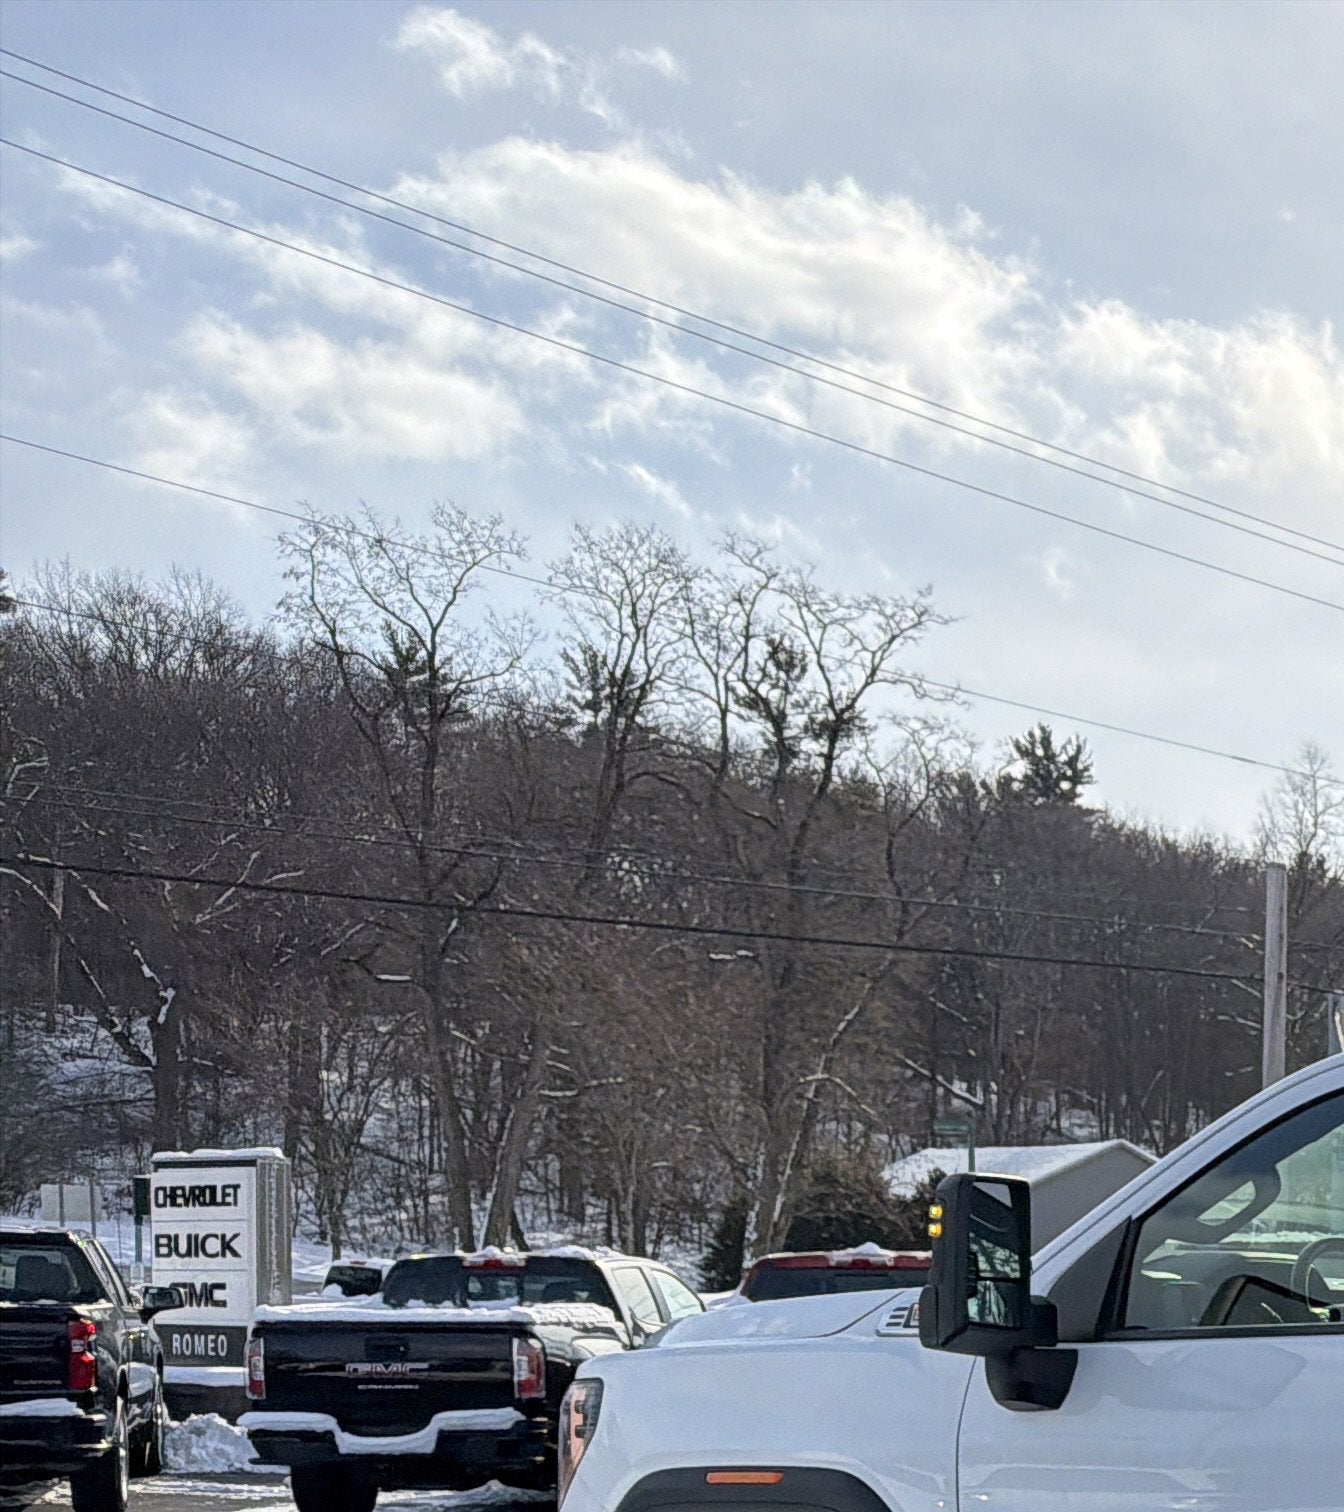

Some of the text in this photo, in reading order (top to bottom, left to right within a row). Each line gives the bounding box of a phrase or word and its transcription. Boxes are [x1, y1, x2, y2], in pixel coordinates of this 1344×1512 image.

[154, 1184, 241, 1209] CHEVROLET
[154, 1233, 241, 1258] BUICK
[172, 1333, 228, 1357] ROMEO
